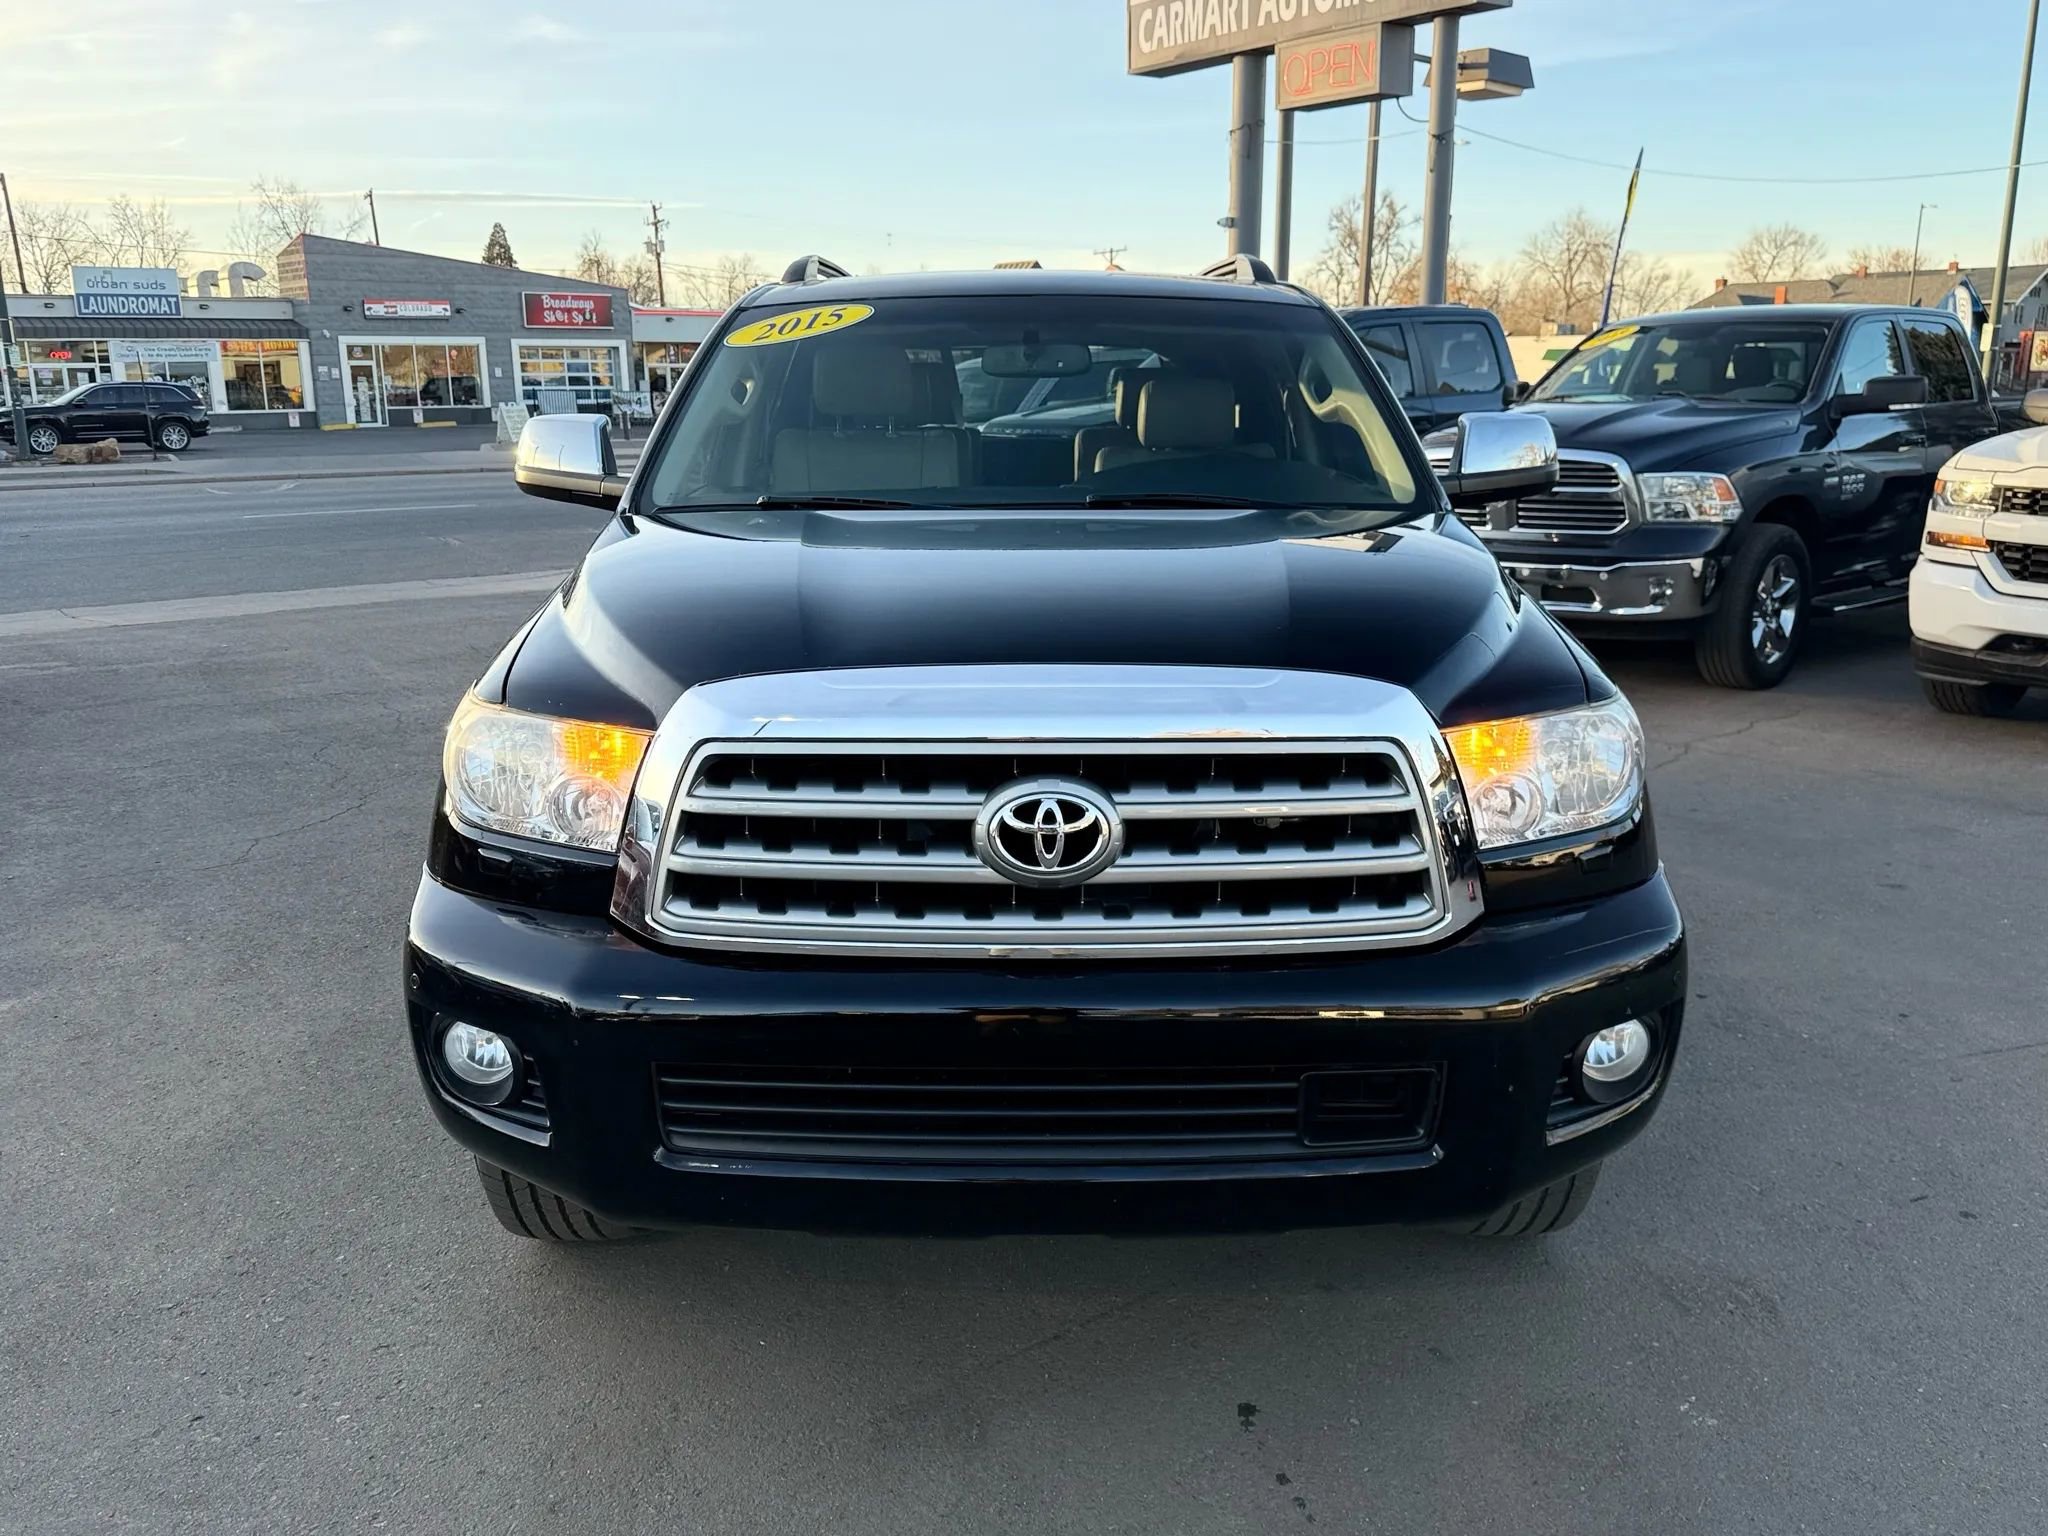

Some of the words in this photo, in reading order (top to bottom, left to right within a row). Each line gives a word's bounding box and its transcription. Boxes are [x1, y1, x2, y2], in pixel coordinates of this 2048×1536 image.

[1283, 40, 1377, 96] OPEN
[86, 276, 128, 289] urban
[133, 280, 166, 290] suds
[79, 295, 177, 314] LAUNDROMAT
[751, 307, 848, 342] 2015
[49, 351, 73, 360] OPEN
